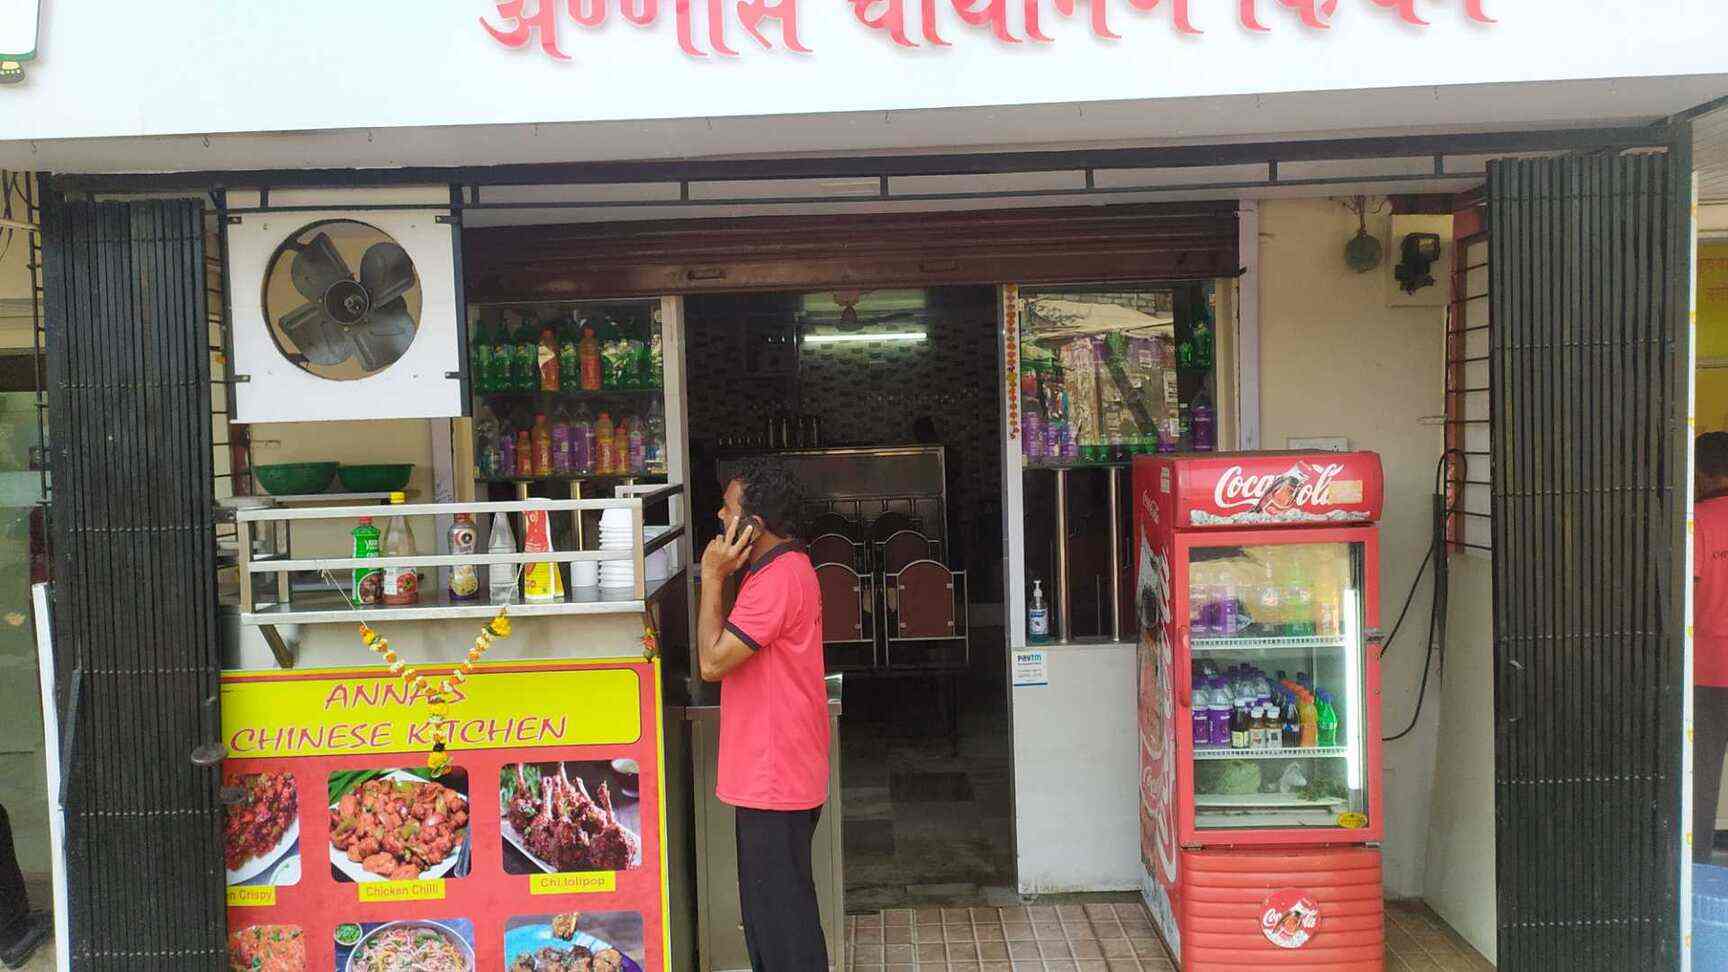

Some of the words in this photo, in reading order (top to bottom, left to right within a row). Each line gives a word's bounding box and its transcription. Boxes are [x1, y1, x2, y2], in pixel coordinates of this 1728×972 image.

[325, 682, 465, 710] ANNAS
[230, 722, 392, 752] CHINESE
[407, 716, 567, 744] KTCHEN
[366, 885, 409, 897] Chicken
